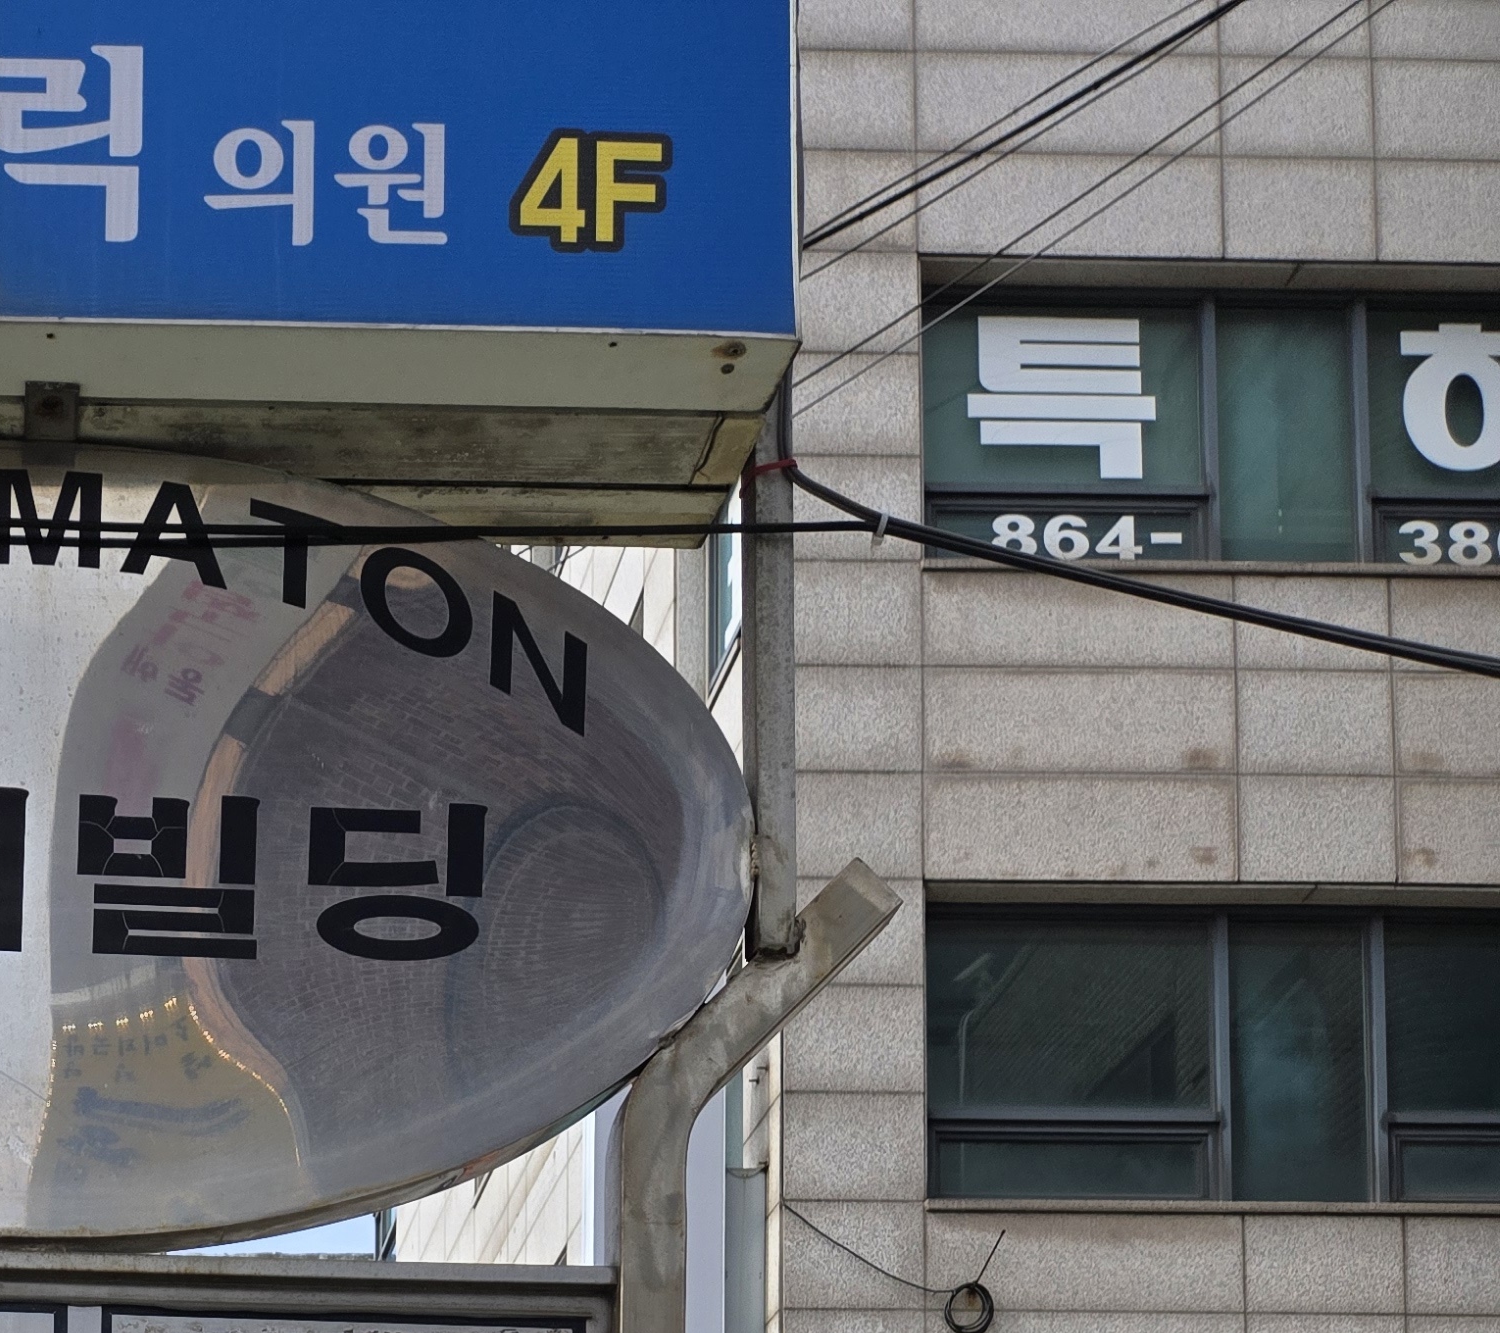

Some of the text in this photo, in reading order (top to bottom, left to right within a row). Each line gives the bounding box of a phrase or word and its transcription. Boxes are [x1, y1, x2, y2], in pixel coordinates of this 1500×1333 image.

[204, 120, 447, 247] 의원
[512, 130, 672, 252] 4F
[1399, 520, 1500, 566] 38
